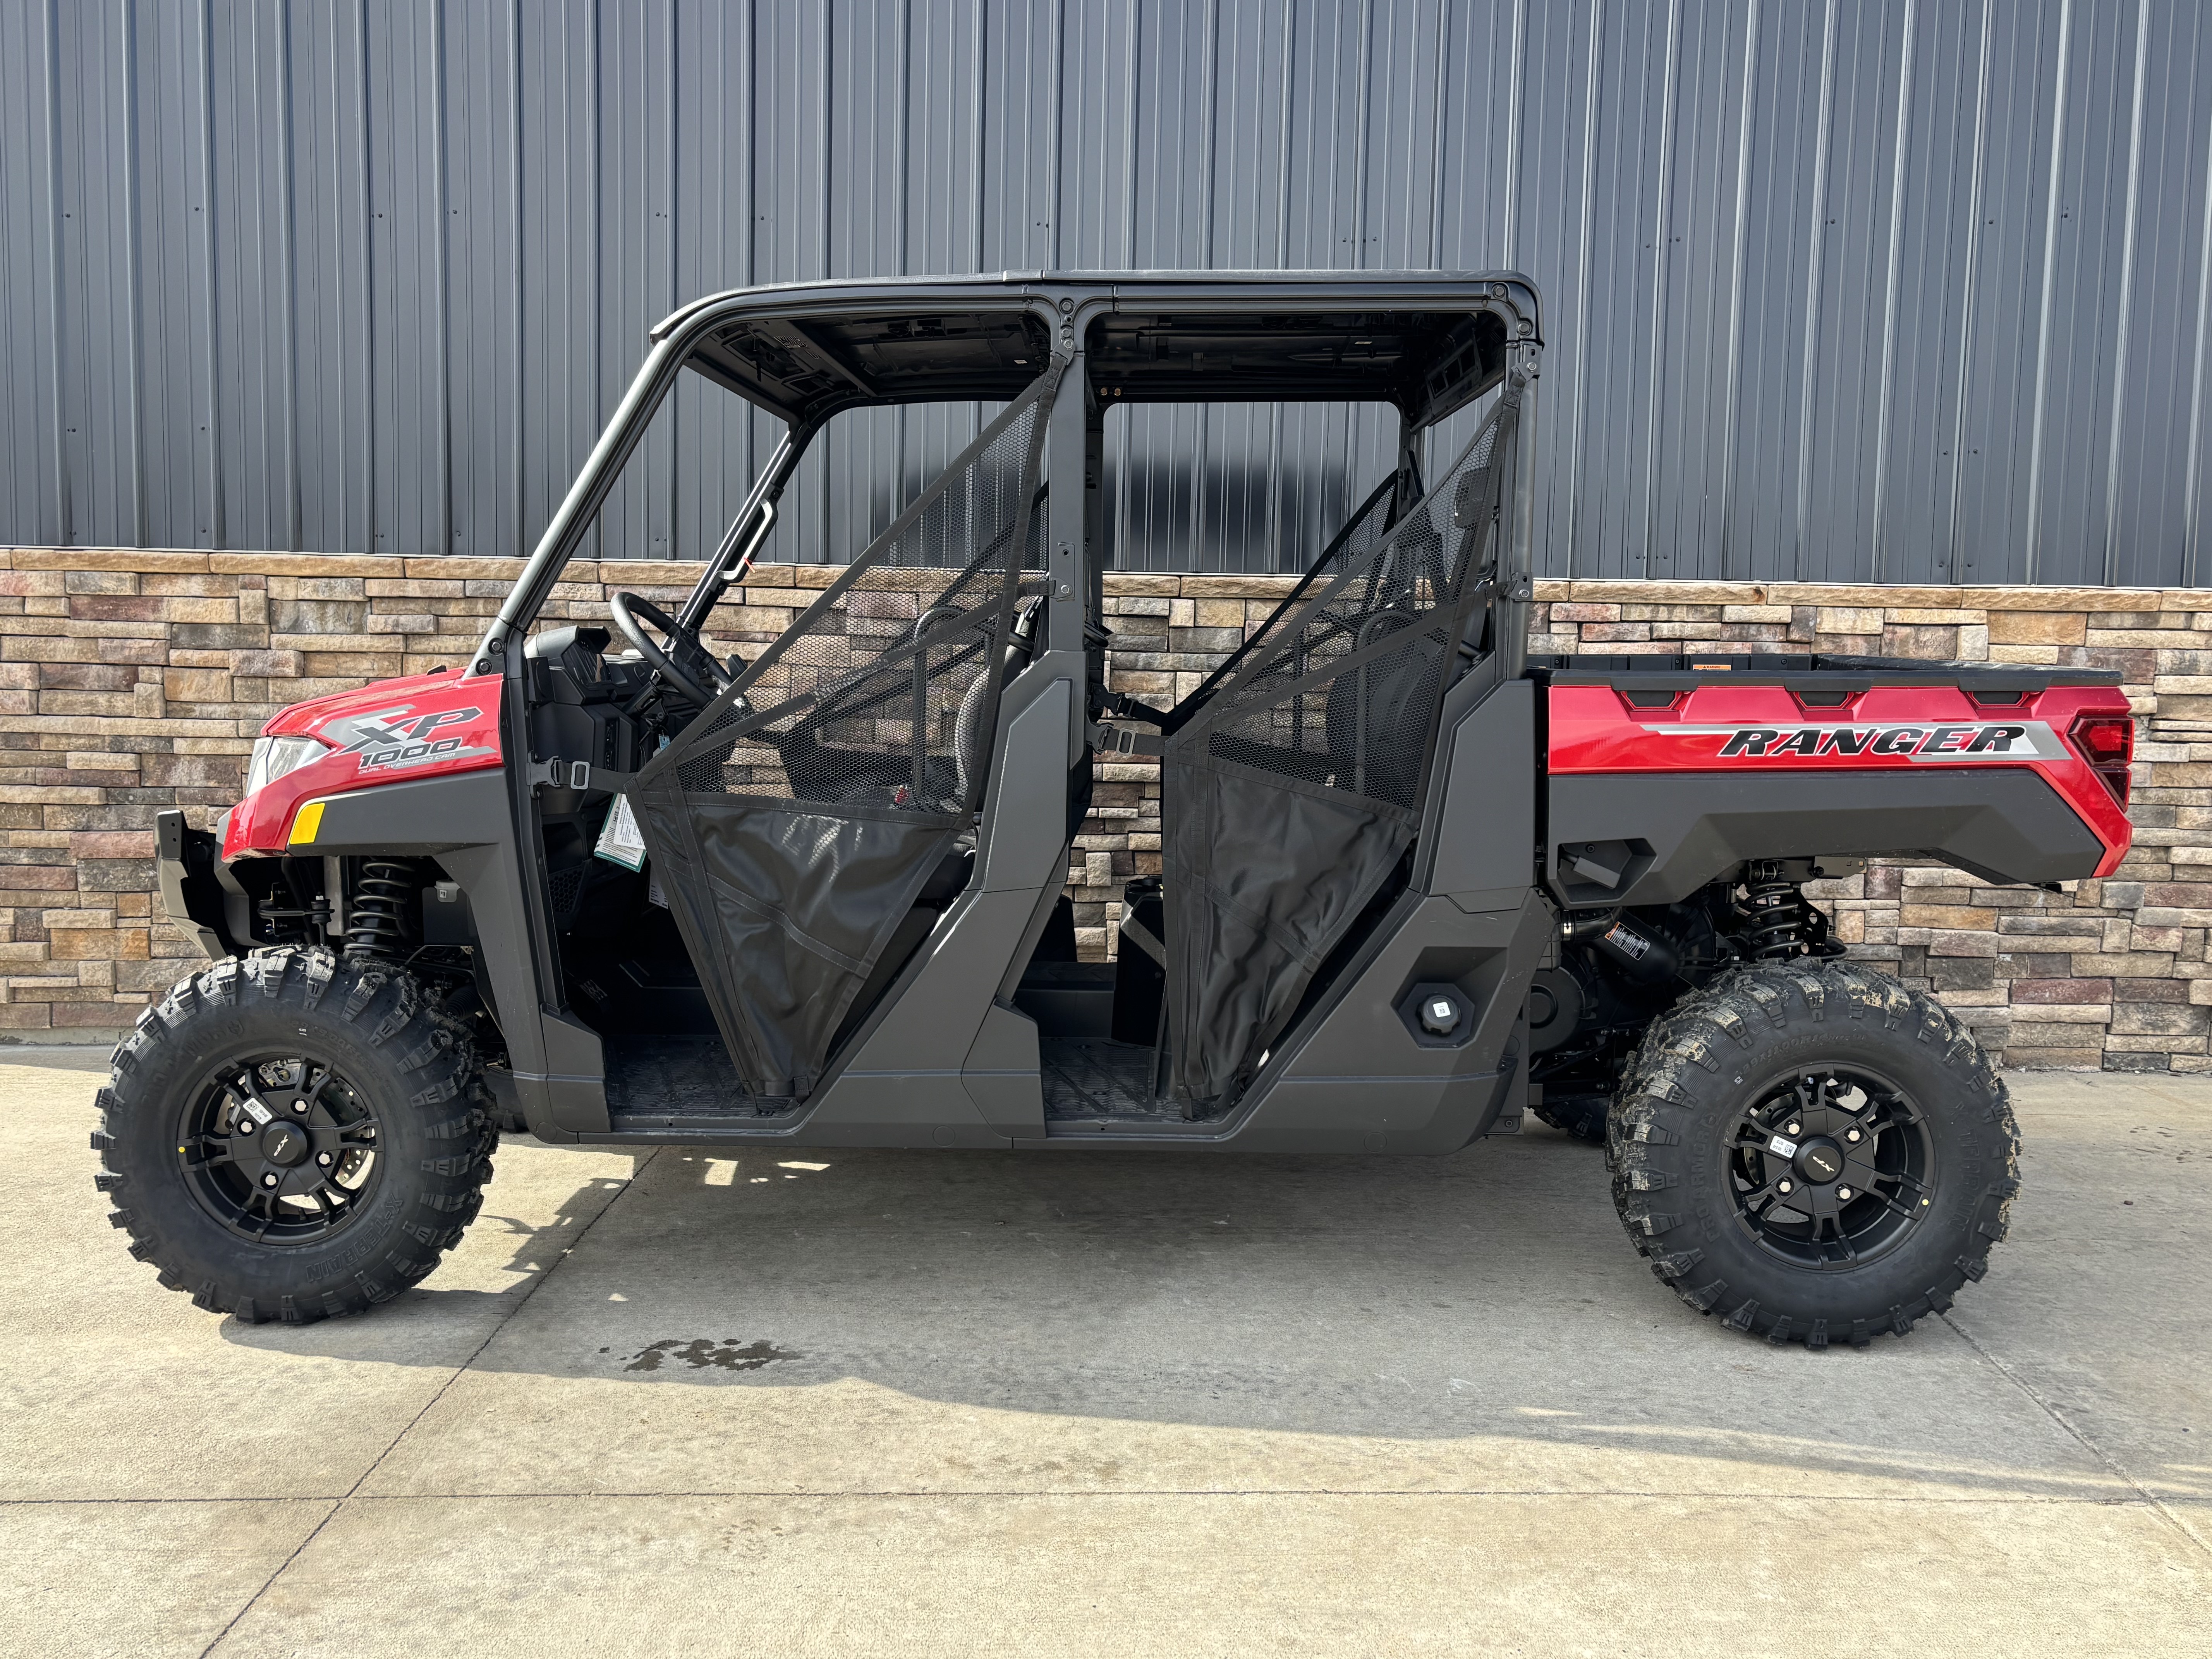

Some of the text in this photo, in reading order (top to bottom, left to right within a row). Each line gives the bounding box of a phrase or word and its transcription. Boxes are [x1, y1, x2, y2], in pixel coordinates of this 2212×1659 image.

[335, 707, 482, 755] XP
[1719, 726, 2027, 756] RANGER
[359, 738, 462, 768] 1000
[384, 756, 433, 769] OVERHEAD
[273, 1134, 289, 1157] XP
[1812, 1156, 1835, 1172] XP
[306, 1193, 403, 1283] X-TERRAIN
